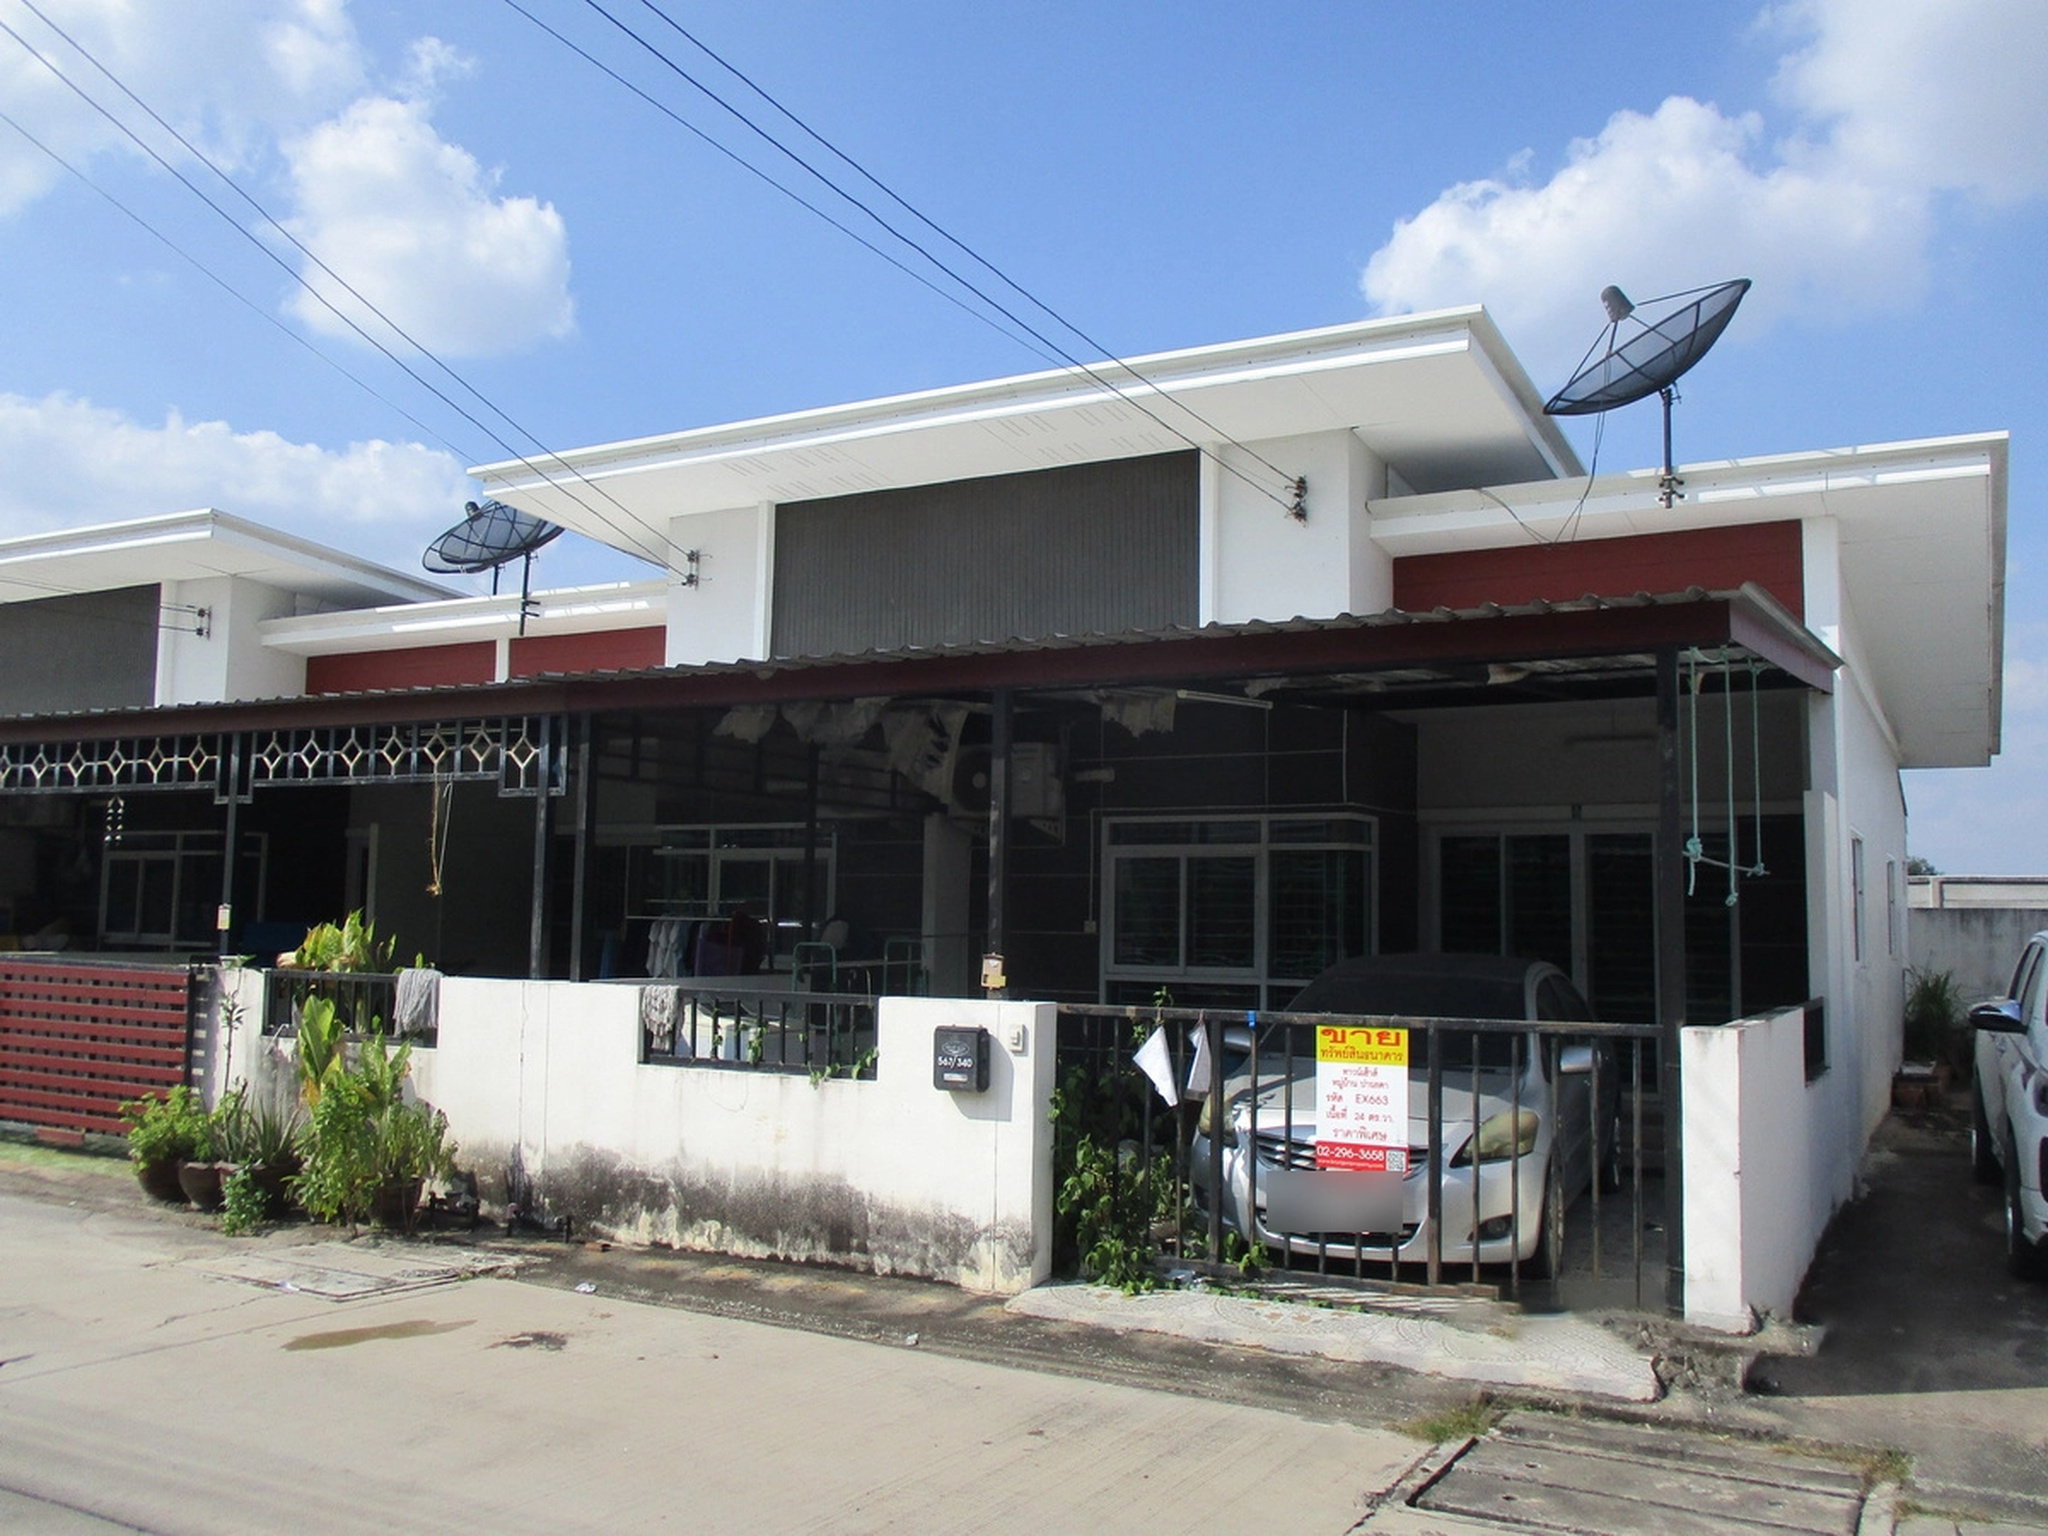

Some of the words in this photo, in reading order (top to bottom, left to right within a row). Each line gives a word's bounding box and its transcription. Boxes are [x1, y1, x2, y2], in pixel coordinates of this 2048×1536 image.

[1321, 1028, 1400, 1046] ขาย
[1321, 1046, 1403, 1061] ทรัพย์สินธนาคาร
[1326, 1092, 1344, 1102] รหัส
[1355, 1093, 1389, 1106] EX663
[1333, 1126, 1387, 1141] ราคาพิเศษ
[1317, 1145, 1384, 1161] 02-296-3658
